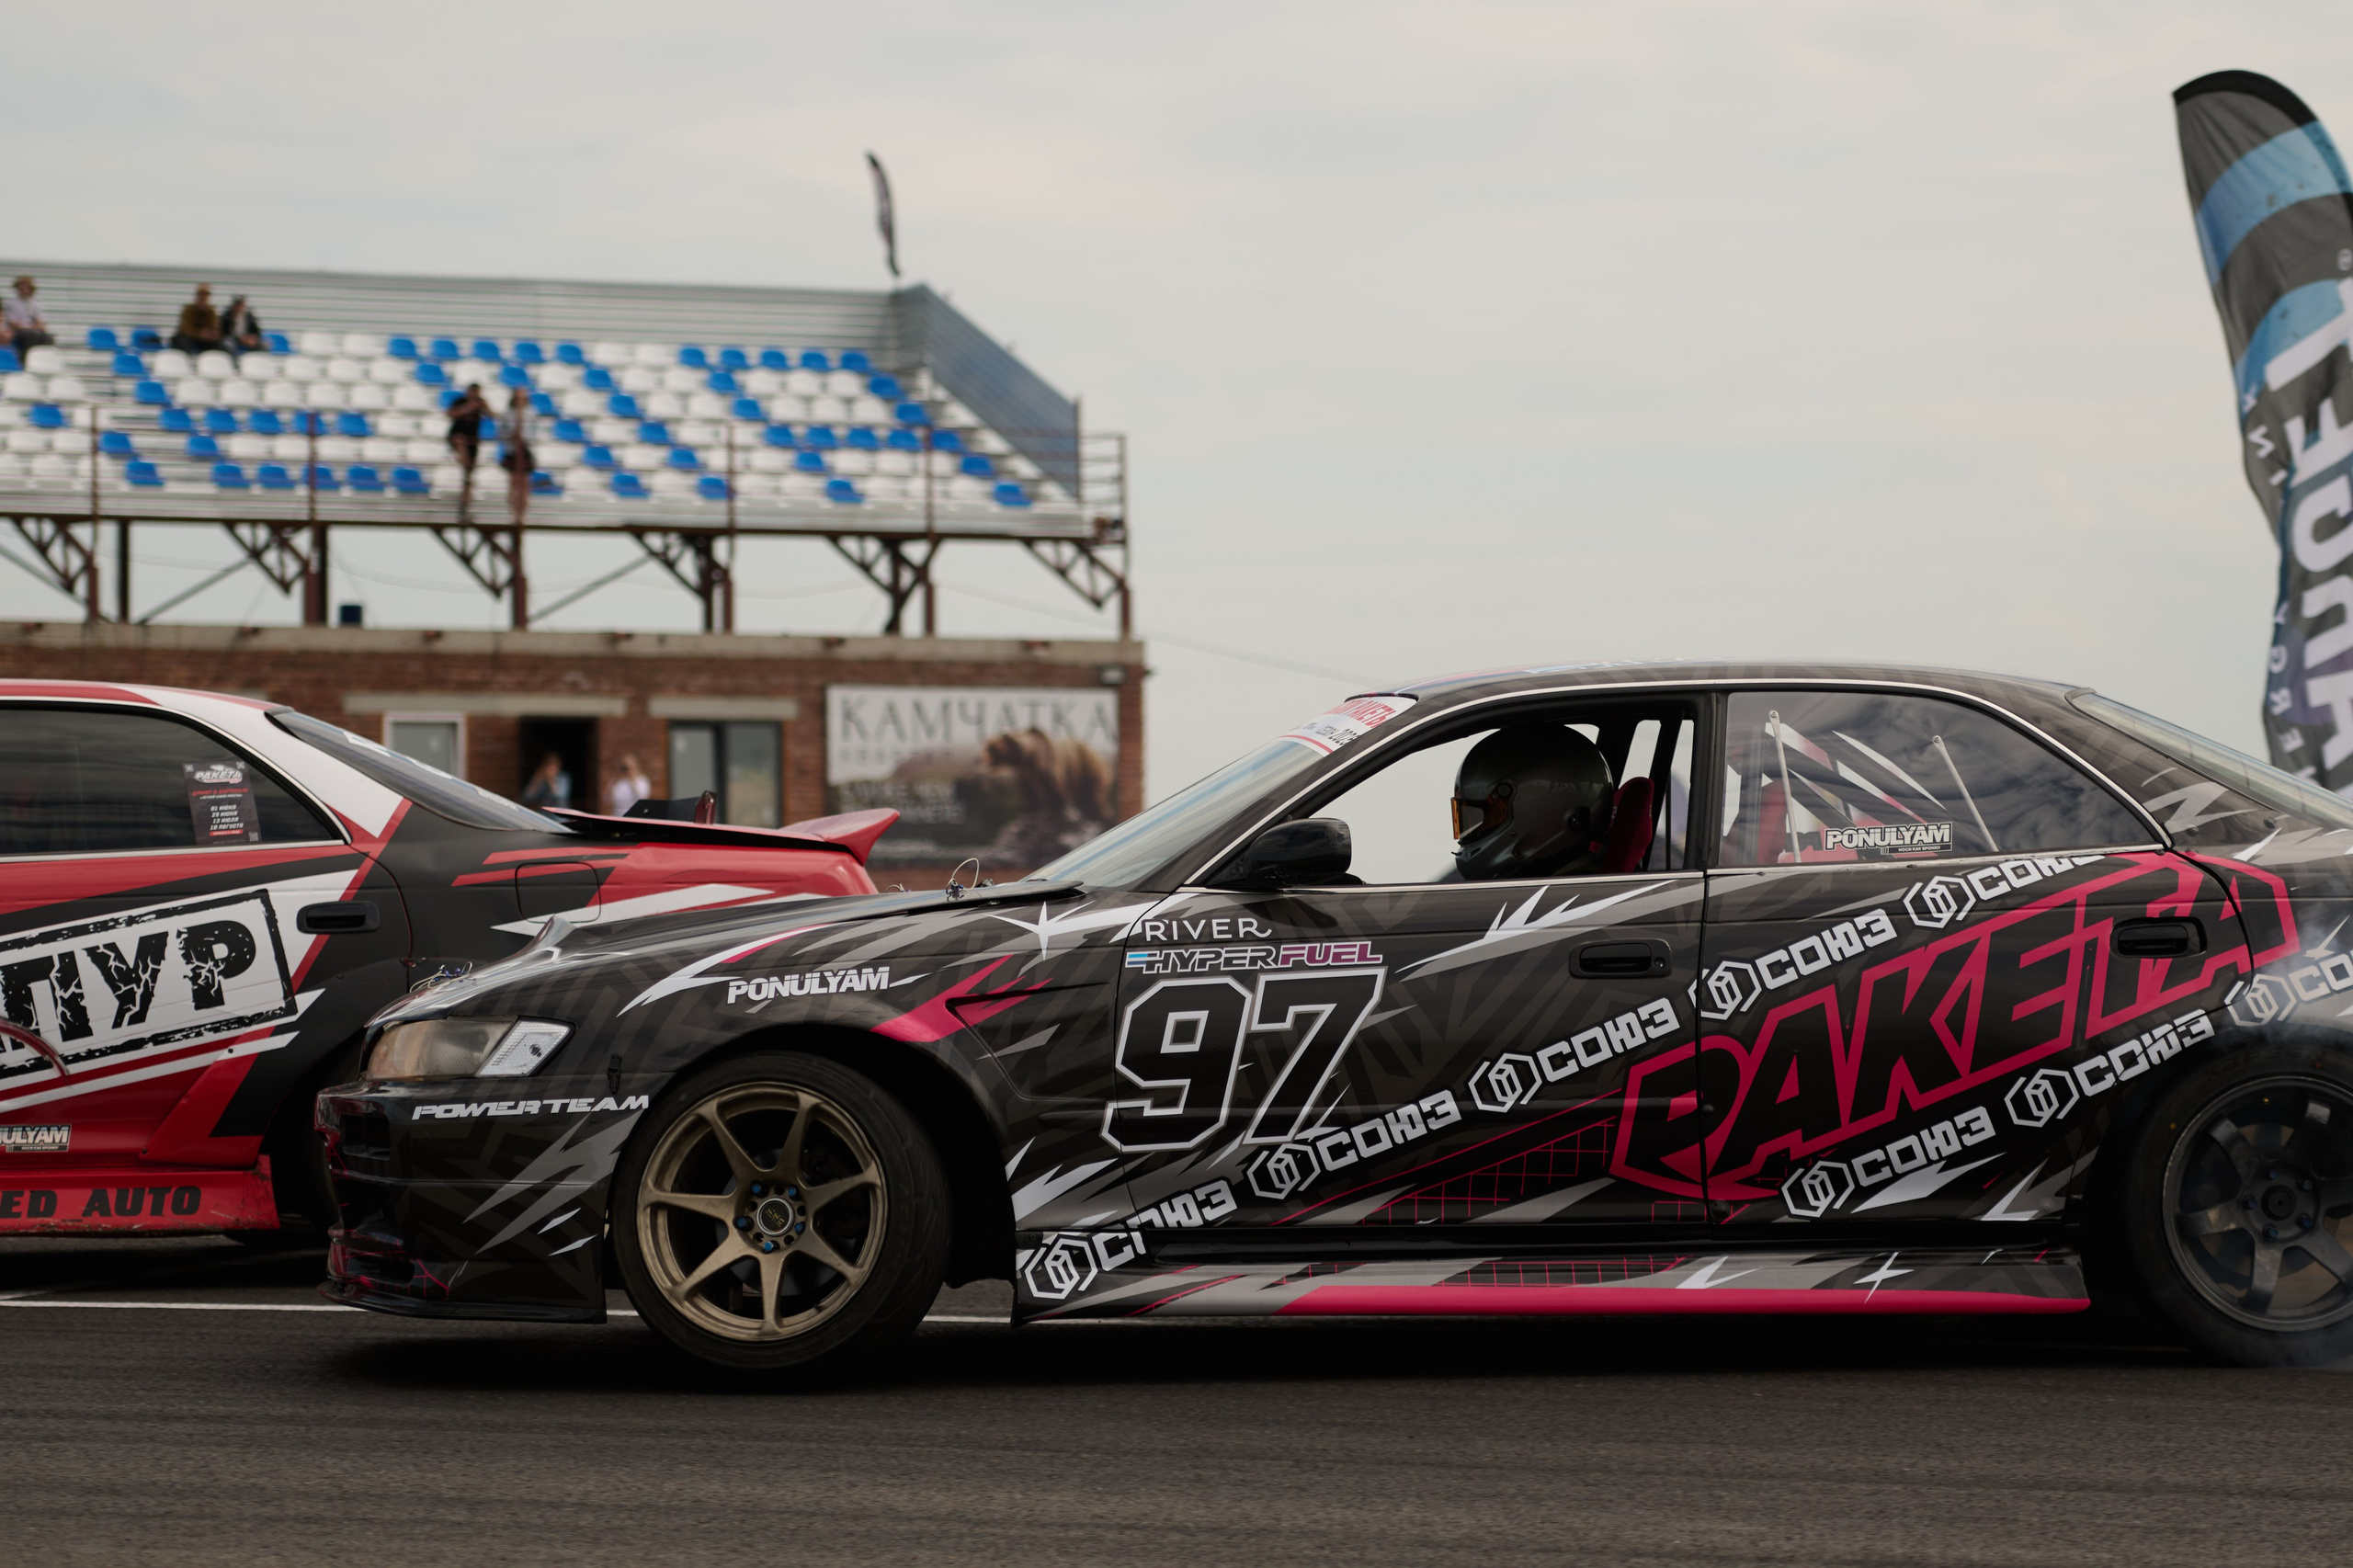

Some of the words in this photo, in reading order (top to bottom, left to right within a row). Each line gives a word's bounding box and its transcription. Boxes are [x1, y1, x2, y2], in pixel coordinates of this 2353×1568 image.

[840, 693, 1118, 742] КАМЧАТКА
[1825, 824, 1950, 850] PONULYAM
[1145, 918, 1272, 941] RIVER
[726, 966, 890, 1004] PONULYAM
[1100, 968, 1388, 1153] 97
[1316, 1089, 1462, 1172] СОЮЗ
[1536, 997, 1681, 1083] СОЮЗ
[1755, 908, 1898, 990] СОЮЗ
[1850, 1106, 1996, 1187] СОЮЗ
[2073, 1008, 2215, 1096] СОЮЗ
[2288, 950, 2353, 1002] СО
